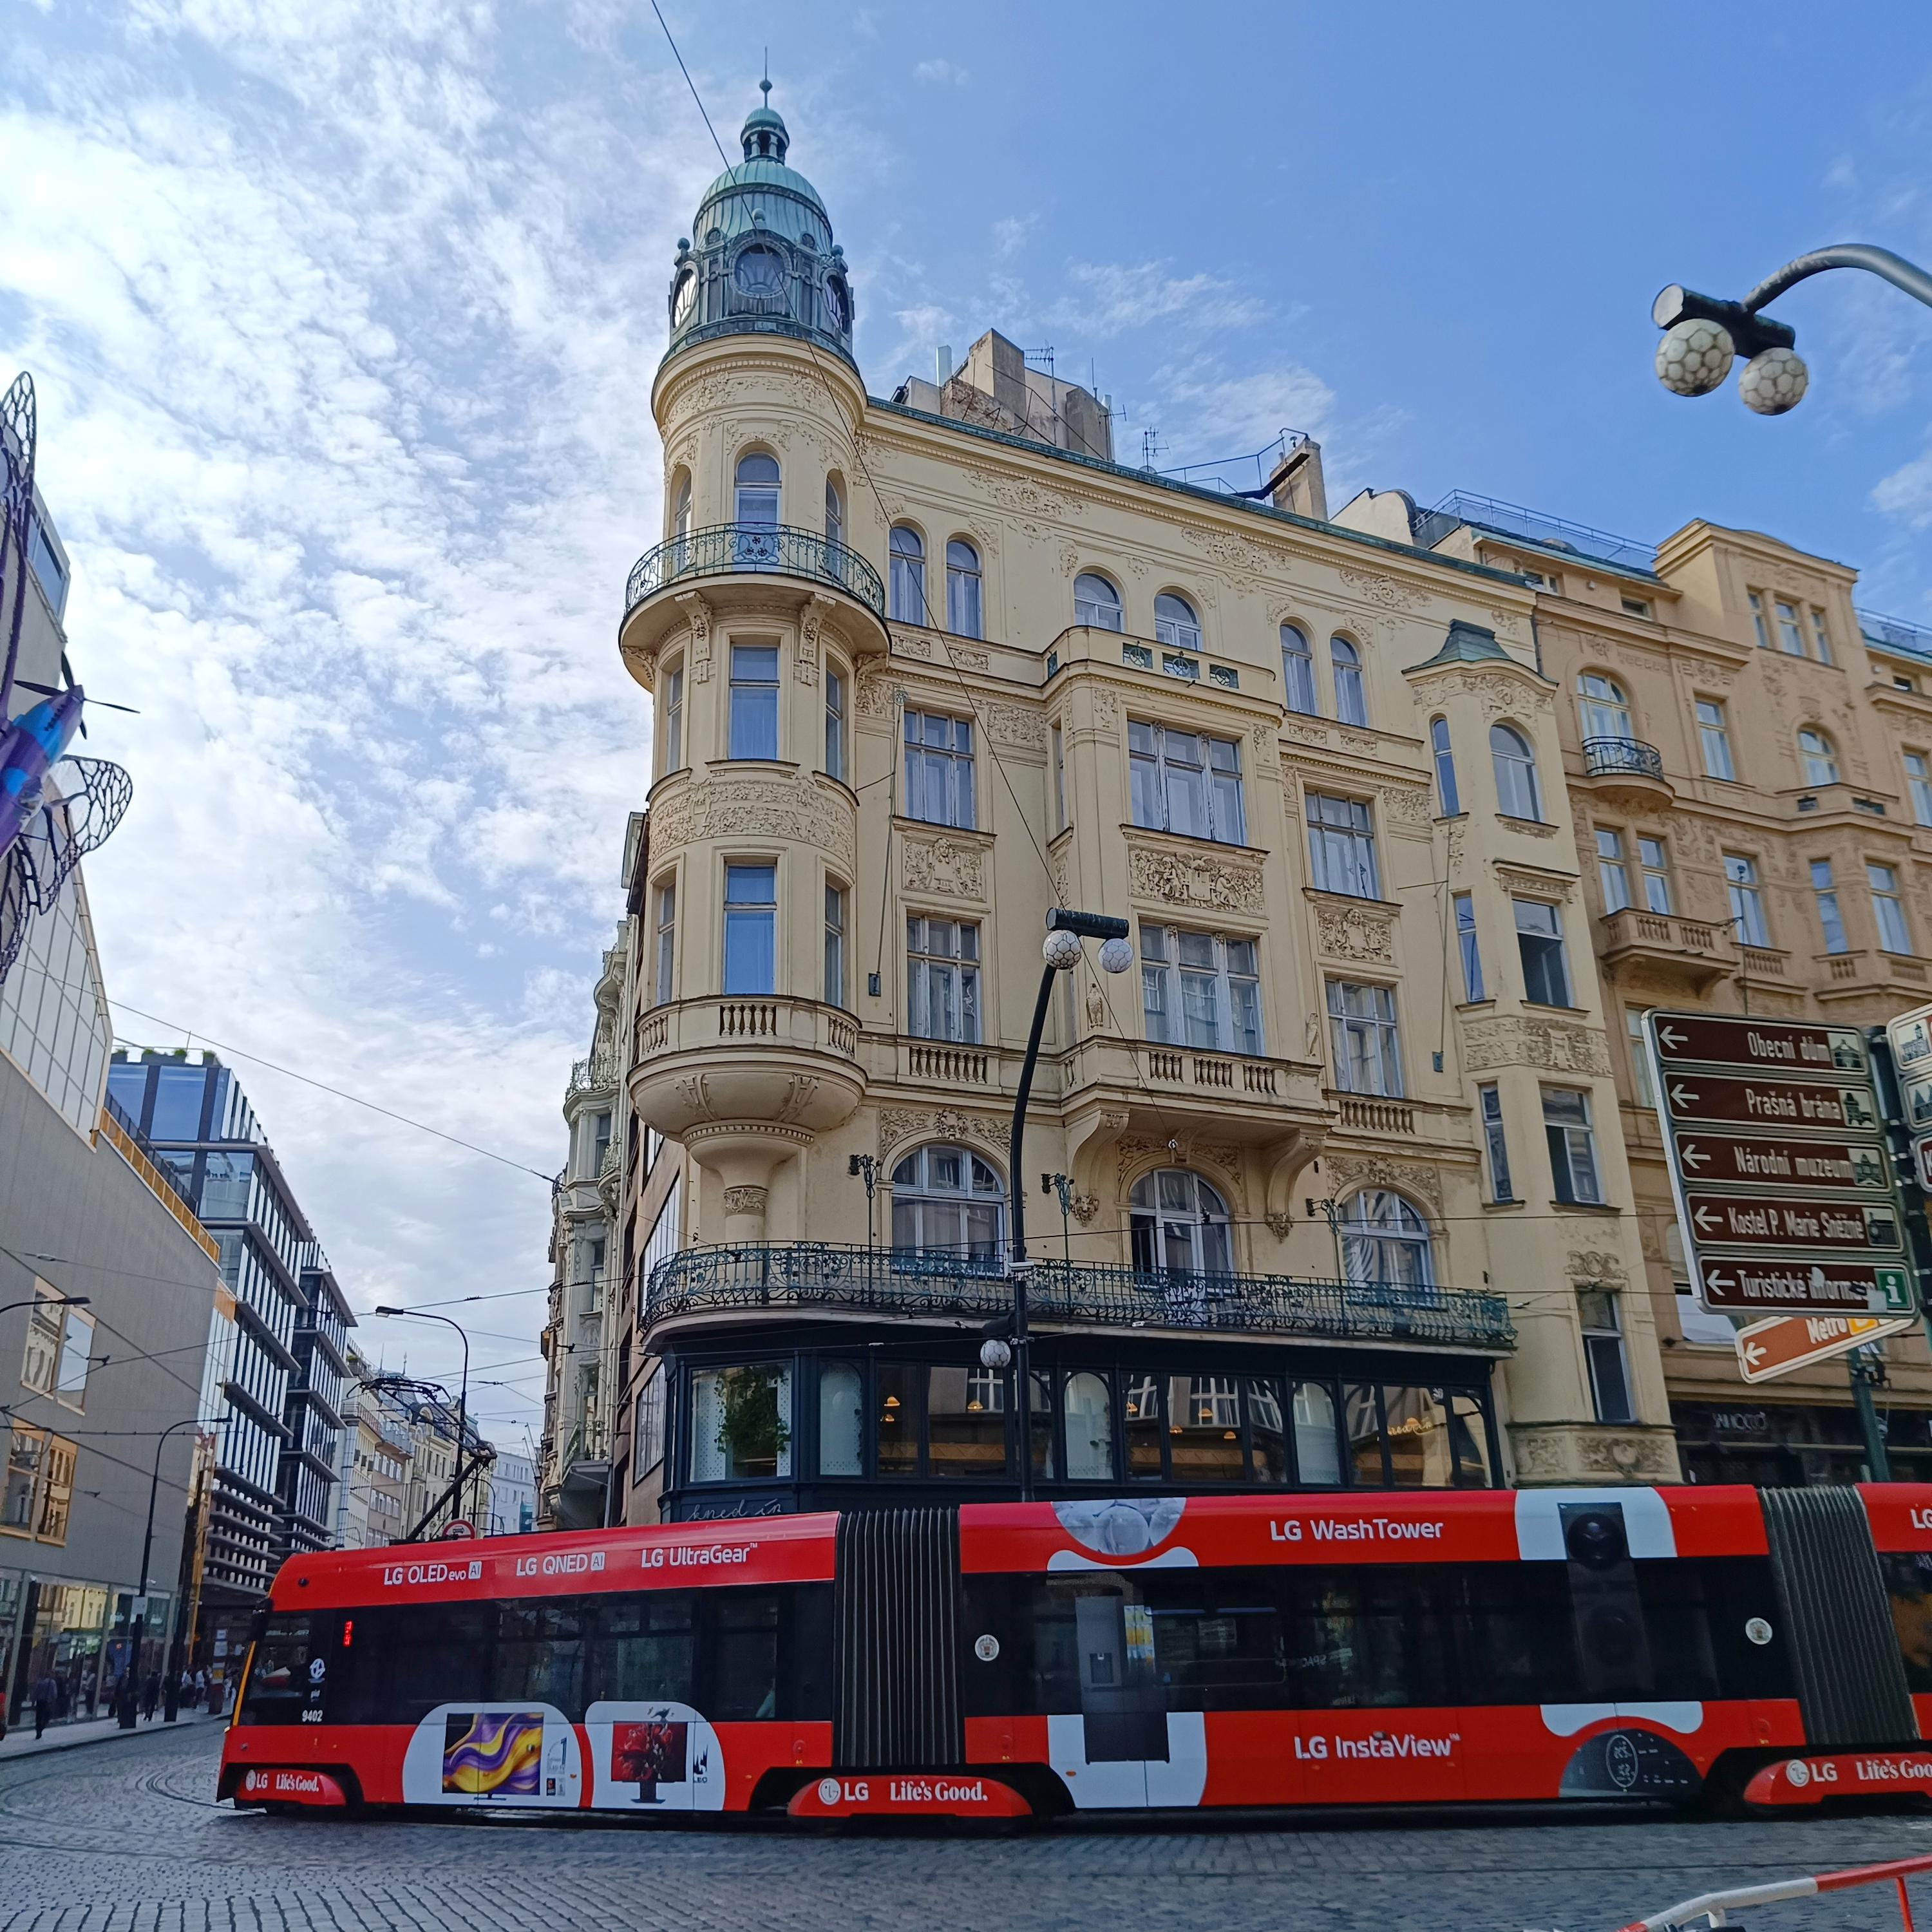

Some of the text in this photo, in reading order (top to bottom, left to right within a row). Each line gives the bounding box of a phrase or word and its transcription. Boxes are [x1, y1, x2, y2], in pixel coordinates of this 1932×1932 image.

[1747, 1031, 1831, 1062] Obecní dům
[1745, 1088, 1842, 1119] Prašná brána
[1734, 1146, 1855, 1179] Národní muzeum
[1727, 1206, 1865, 1239] Kostel P. Marie Sněžné
[1736, 1269, 1807, 1299] Turistické
[1806, 1317, 1848, 1345] Metro
[1270, 1519, 1444, 1541] LG WashTower
[516, 1557, 537, 1577] LG
[542, 1554, 588, 1575] QNED
[641, 1548, 664, 1568] LG
[383, 1567, 403, 1586] LG
[408, 1564, 448, 1584] OLED
[449, 1570, 466, 1581] evo
[302, 1710, 323, 1723] 9402
[1294, 1735, 1328, 1759] LG
[256, 1772, 269, 1789] LG
[1810, 1763, 1838, 1783] LG
[1855, 1759, 1899, 1781] Life's
[844, 1780, 989, 1801] LG Life's Good.
